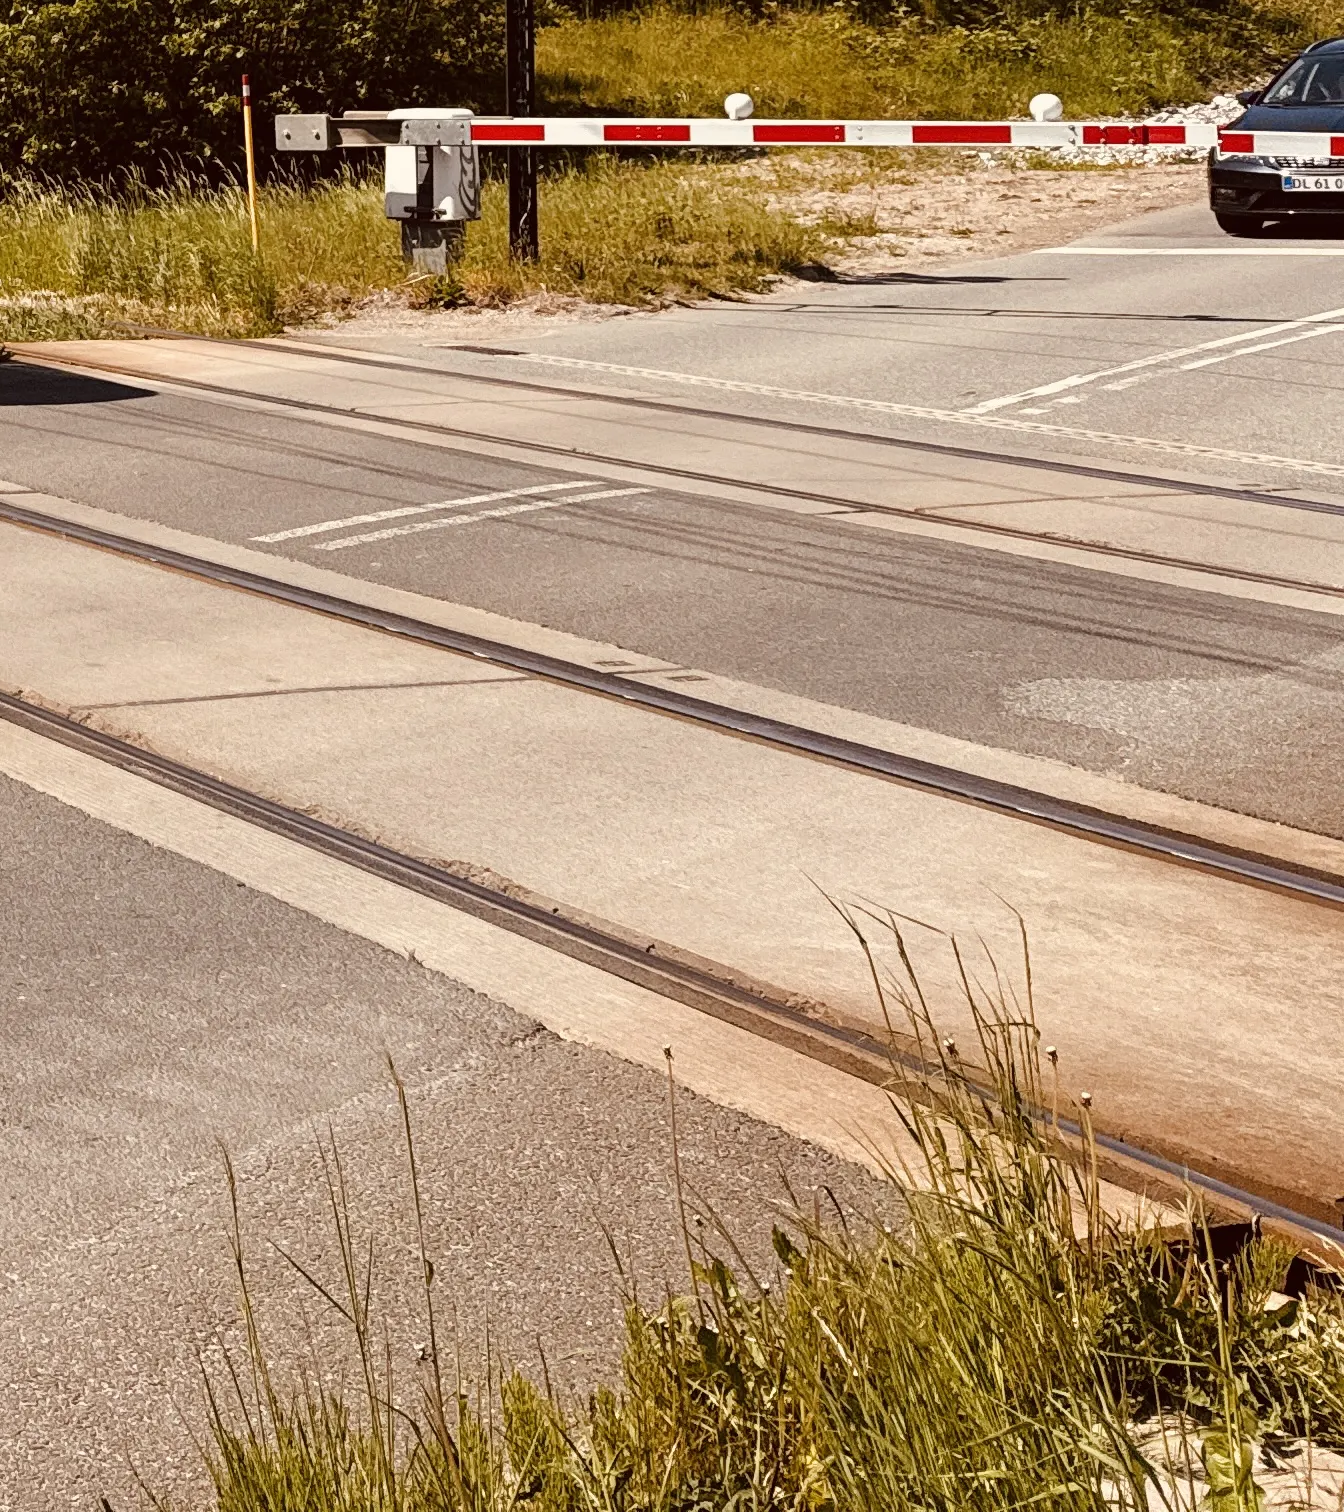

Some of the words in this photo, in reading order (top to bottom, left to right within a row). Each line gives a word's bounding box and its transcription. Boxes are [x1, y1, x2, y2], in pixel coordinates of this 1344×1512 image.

[1292, 178, 1311, 189] DL
[1314, 178, 1330, 189] 61
[1335, 178, 1344, 189] 0
